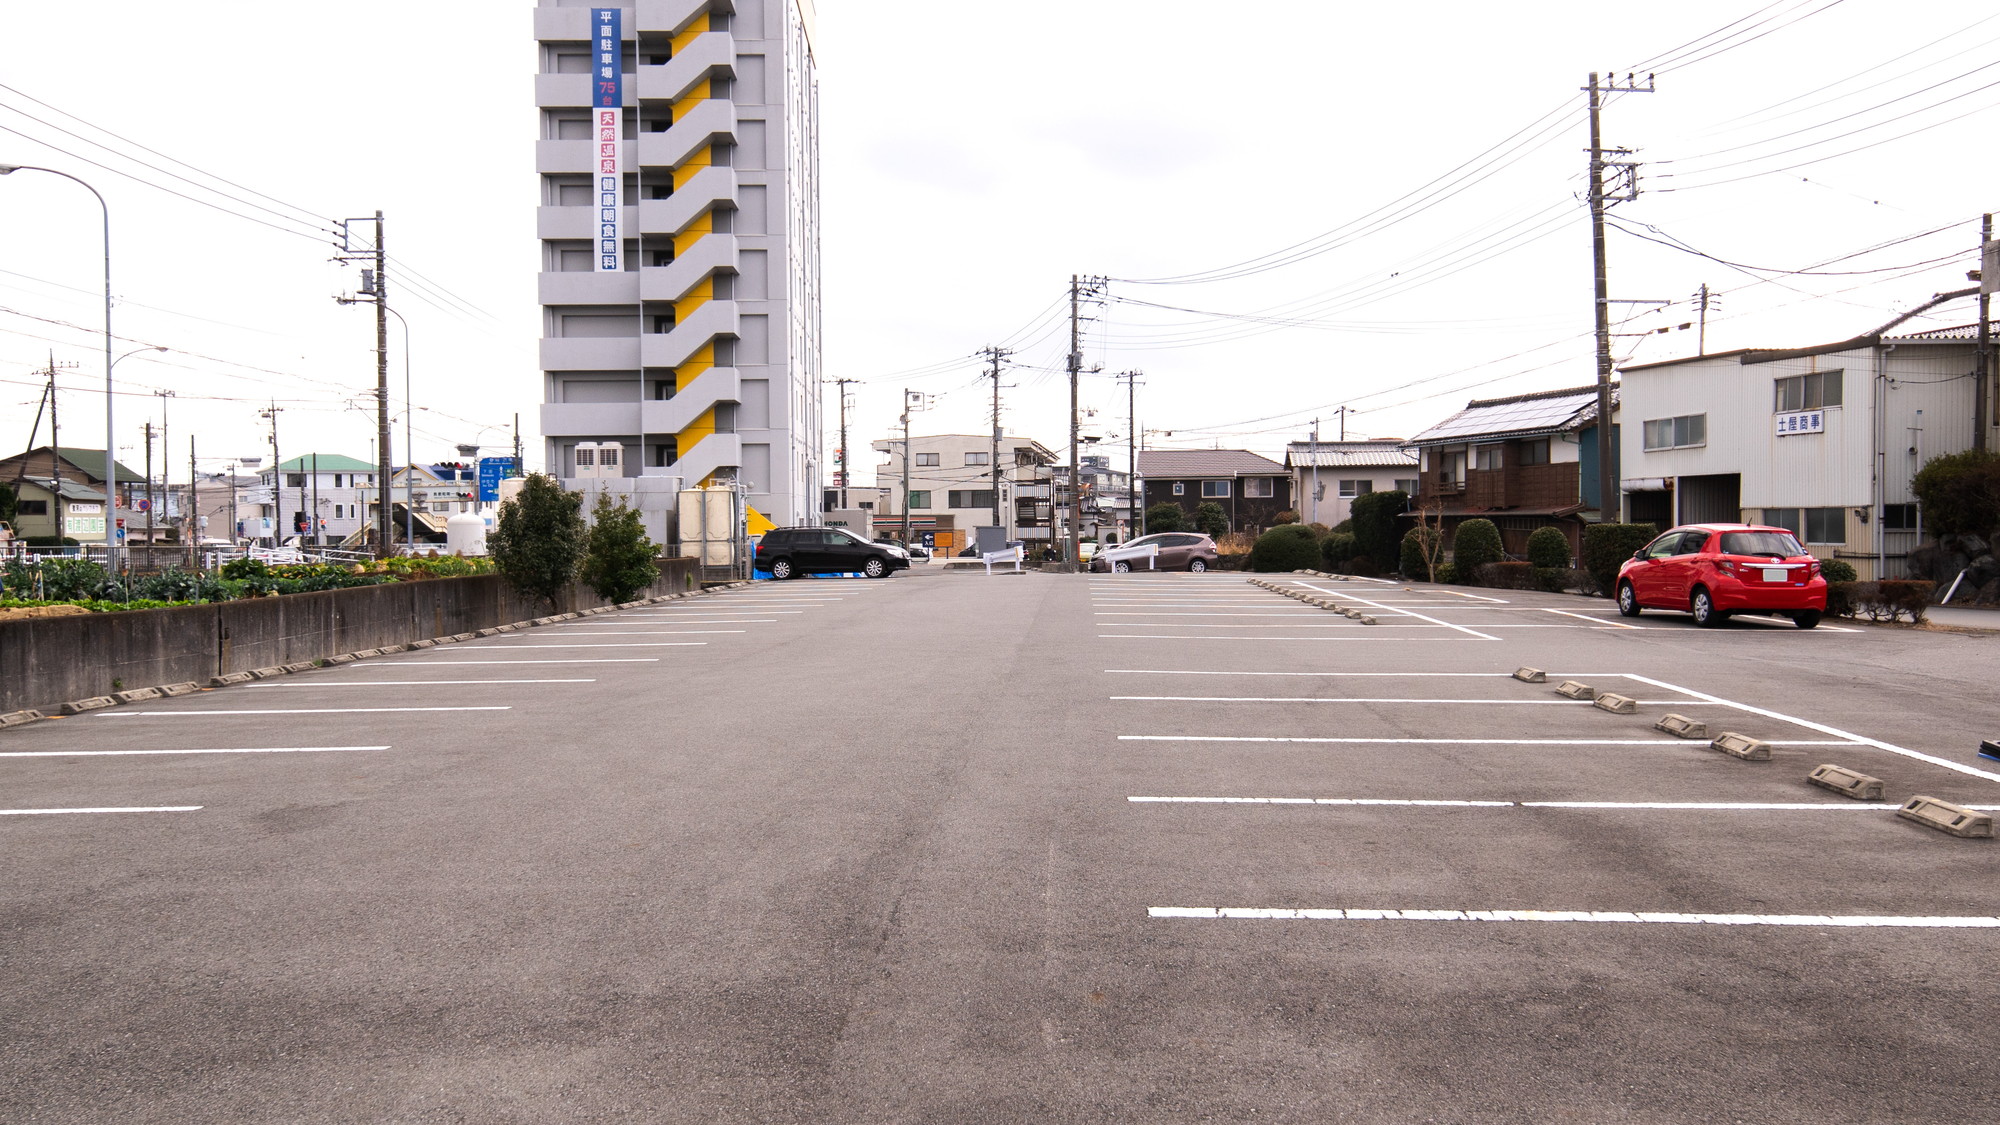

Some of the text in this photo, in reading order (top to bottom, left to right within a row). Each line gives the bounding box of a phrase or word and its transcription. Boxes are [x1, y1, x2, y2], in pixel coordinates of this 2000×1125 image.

[601, 113, 616, 269] 天然温泉 健康朝食無料
[1778, 414, 1820, 432] 土屋商事
